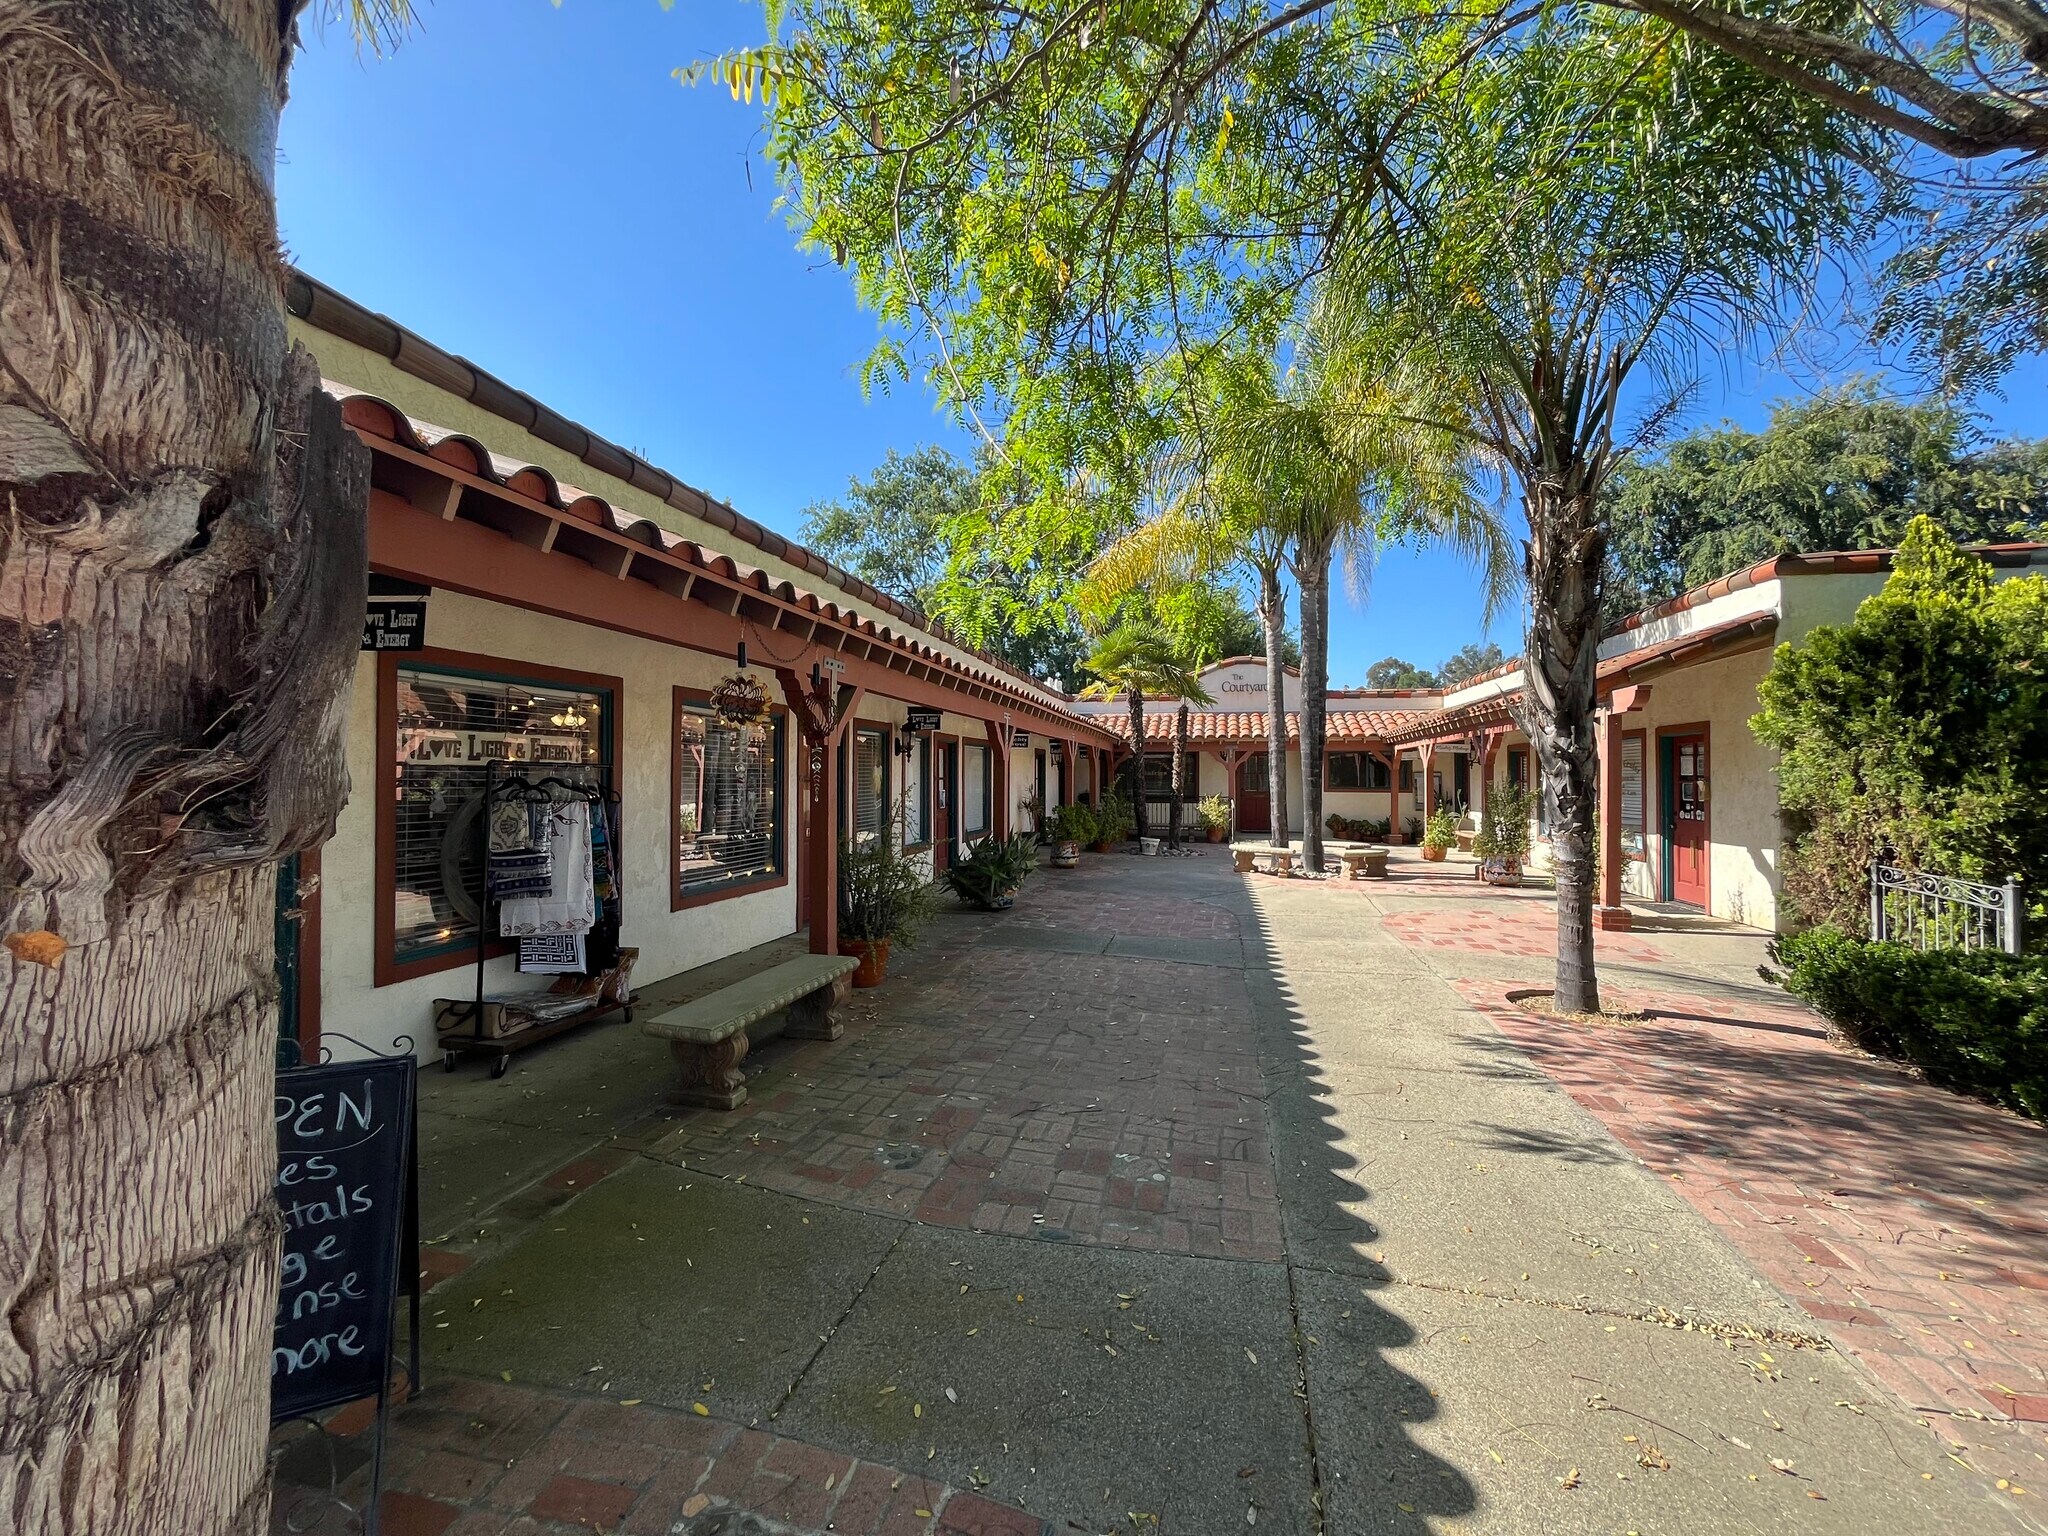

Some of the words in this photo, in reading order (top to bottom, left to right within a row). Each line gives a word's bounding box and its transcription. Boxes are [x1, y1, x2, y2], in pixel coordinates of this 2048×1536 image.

[390, 609, 418, 628] LIGHT
[363, 633, 372, 644] &
[375, 629, 411, 648] ENERGY
[467, 734, 512, 762] LIGHT
[515, 742, 526, 759] &
[274, 1078, 373, 1137] PEN
[281, 1184, 373, 1235] tals
